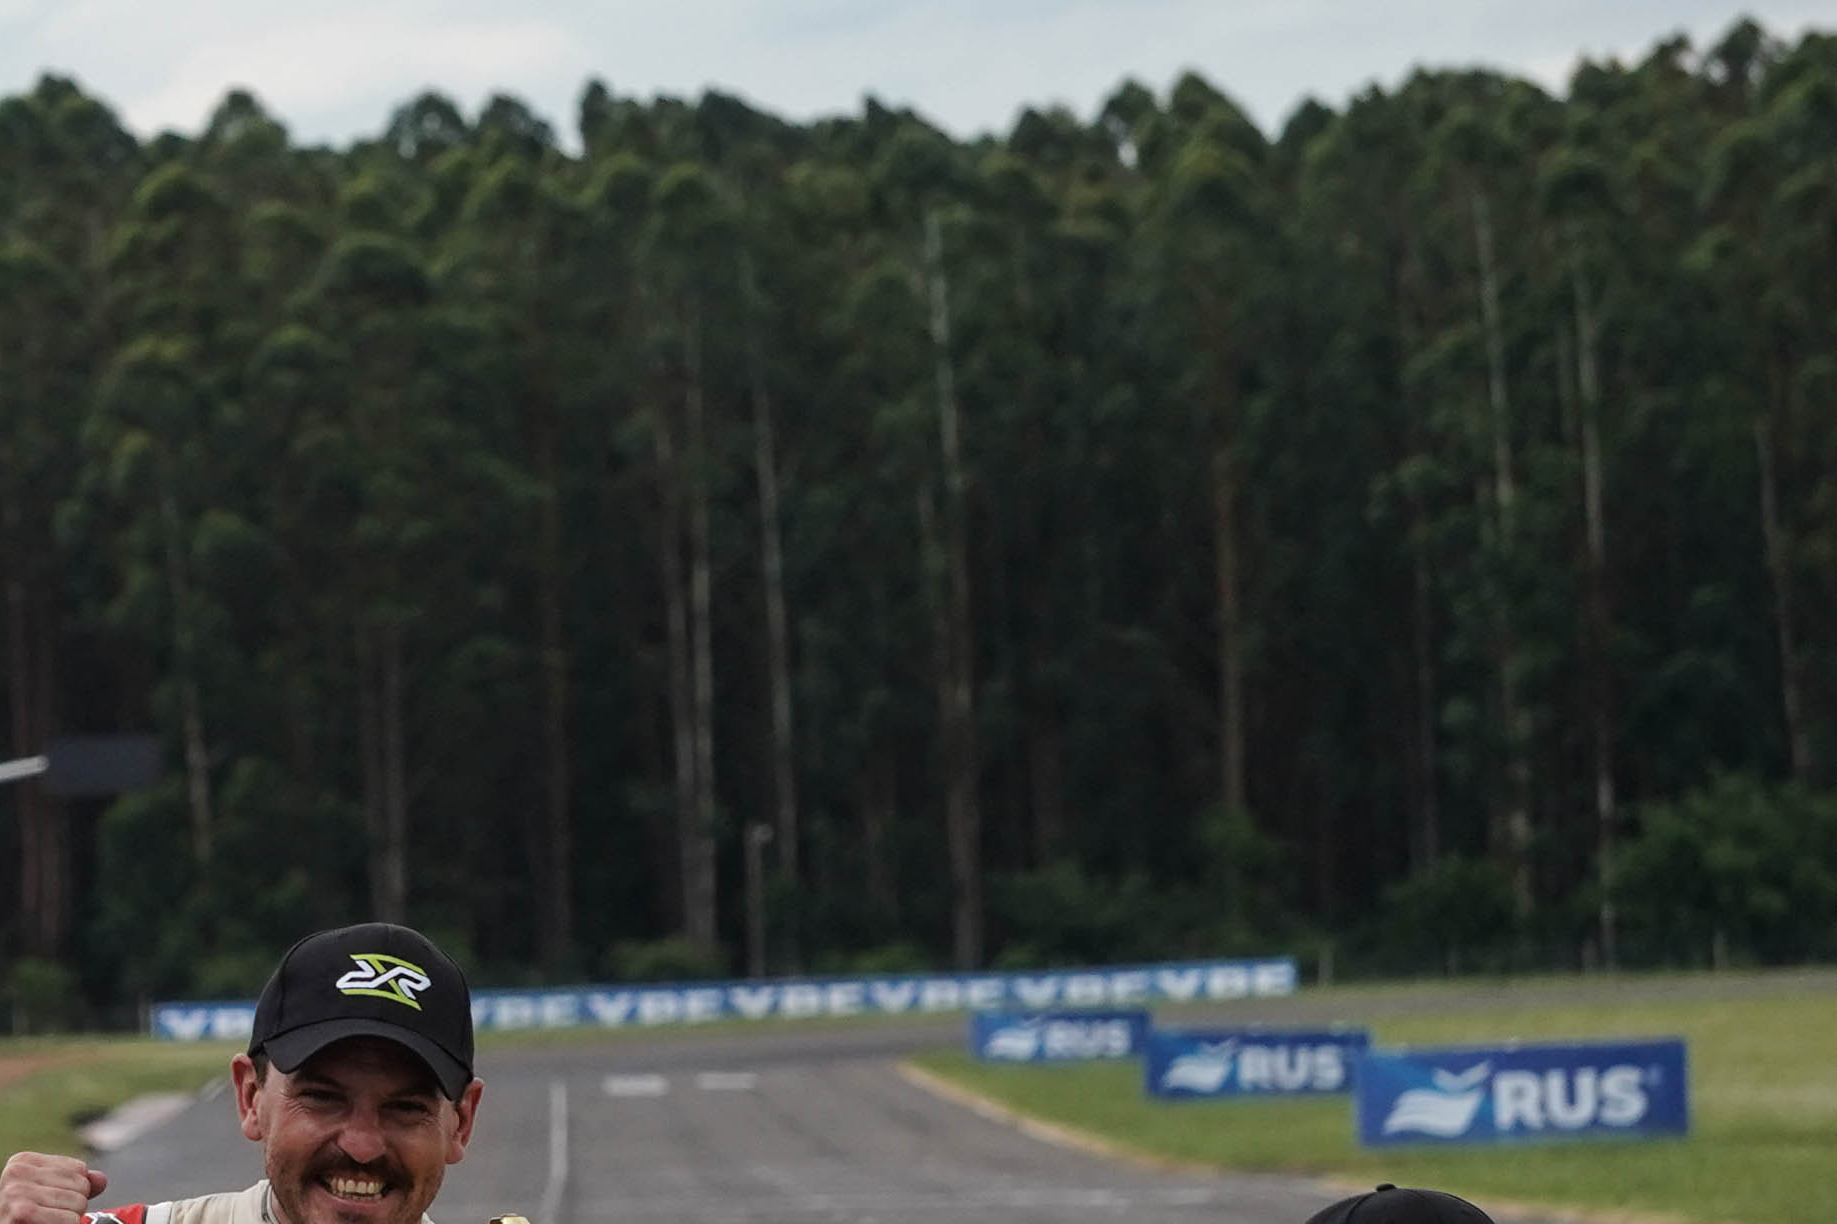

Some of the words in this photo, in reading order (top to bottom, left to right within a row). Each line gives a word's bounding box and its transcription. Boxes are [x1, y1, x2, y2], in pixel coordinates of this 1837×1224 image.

[1042, 1018, 1133, 1058] RUS
[1236, 1044, 1345, 1092] RUS
[1493, 1064, 1650, 1130] RUS
